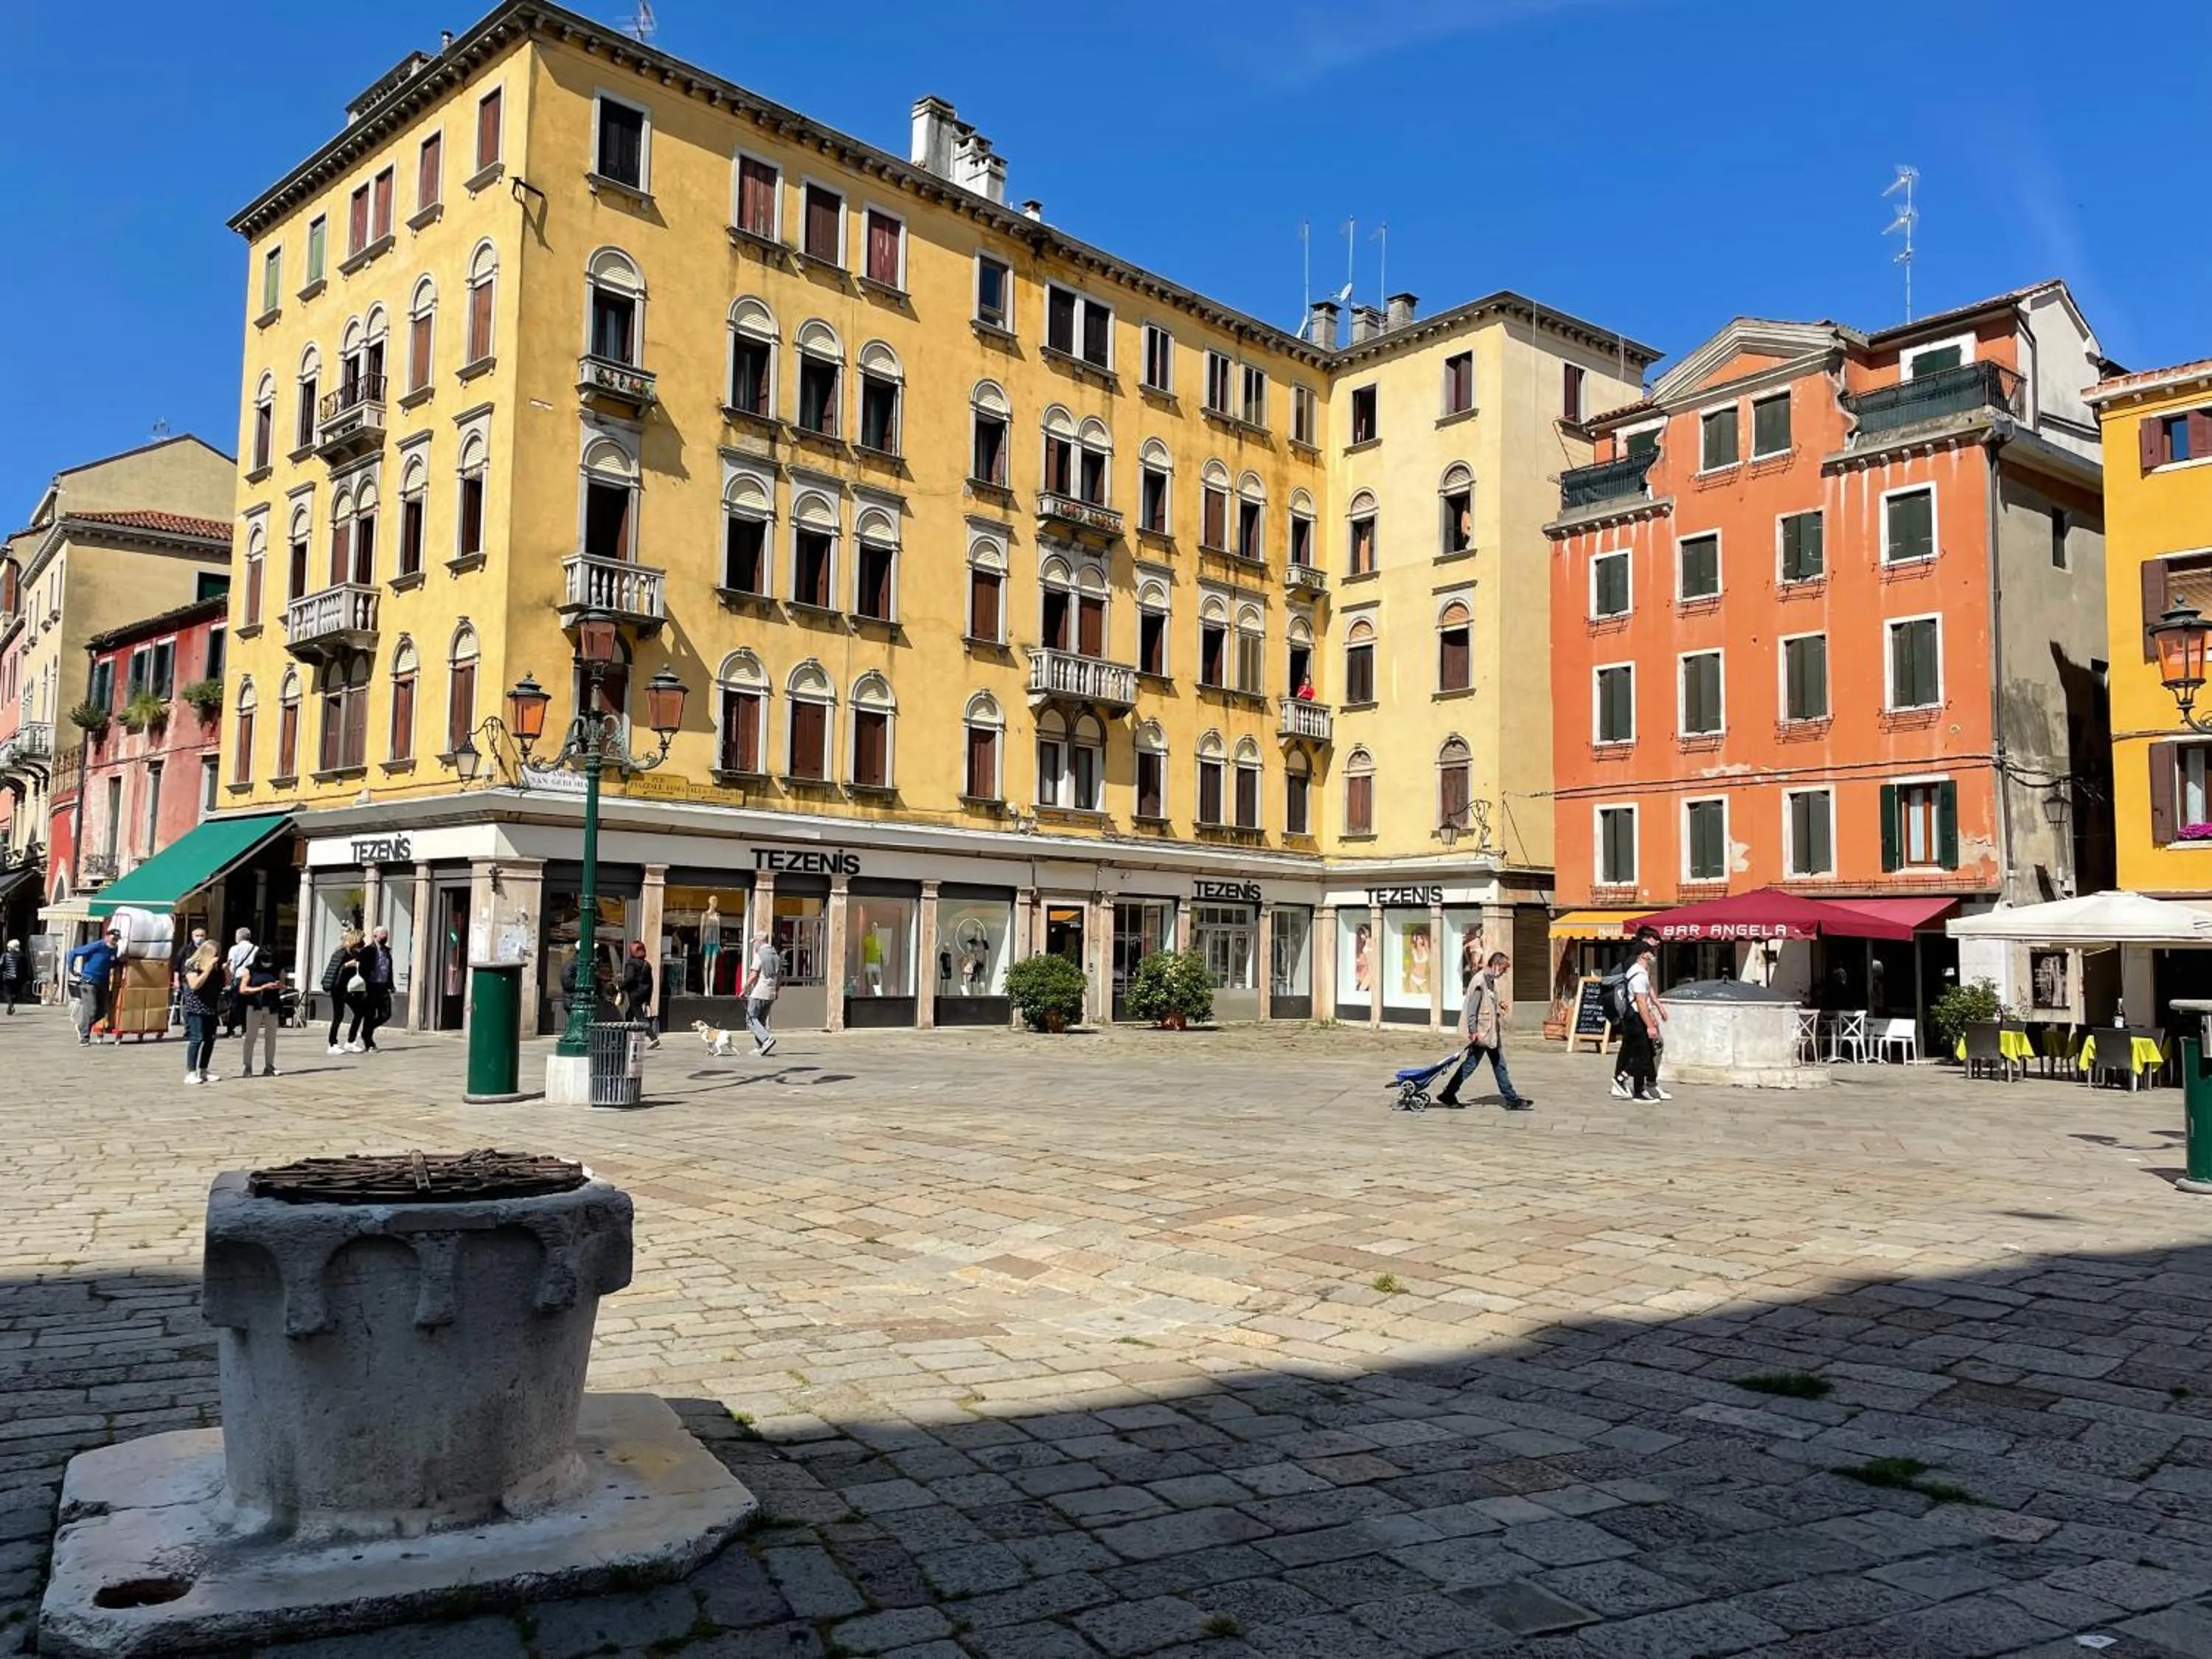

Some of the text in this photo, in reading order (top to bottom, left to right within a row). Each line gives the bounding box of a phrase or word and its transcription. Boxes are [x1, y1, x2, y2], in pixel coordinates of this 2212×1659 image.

[351, 832, 411, 862] TEZENIS
[751, 849, 860, 874] TEZENIS
[1194, 880, 1261, 900] TEZENIS
[1365, 886, 1442, 904] TEZENIS
[1663, 925, 1787, 936] BAR ANGELA
